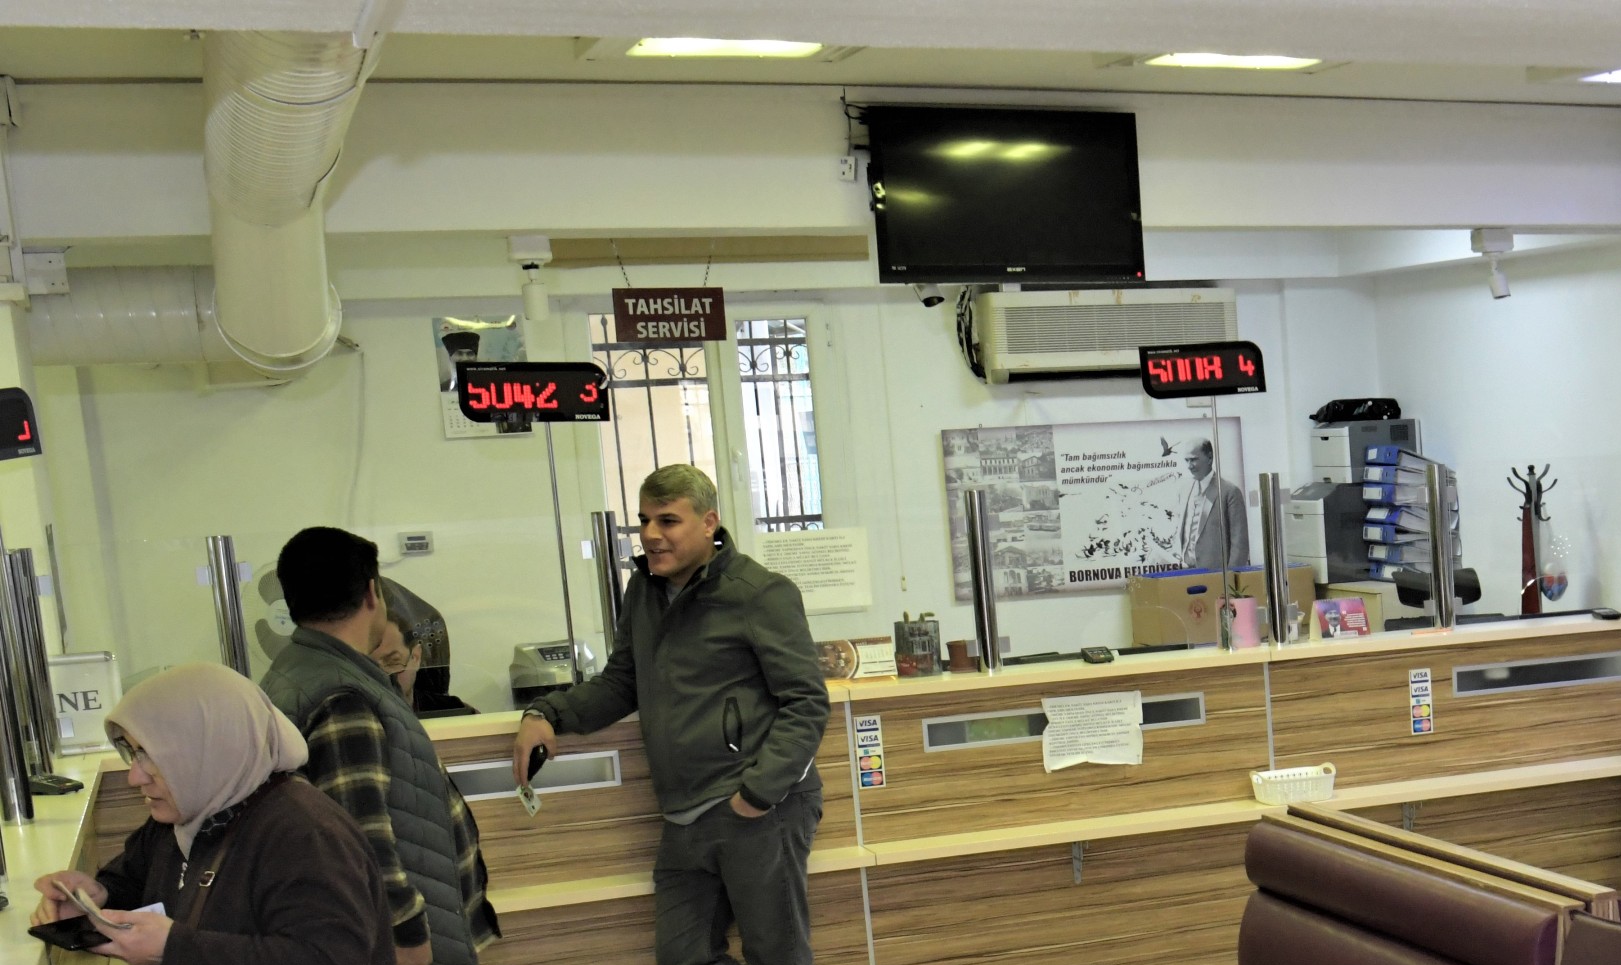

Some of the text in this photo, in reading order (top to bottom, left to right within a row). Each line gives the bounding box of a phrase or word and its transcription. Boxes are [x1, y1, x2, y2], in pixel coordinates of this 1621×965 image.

[624, 294, 713, 315] TAHSİLAT
[636, 317, 706, 338] SERVİSİ
[1238, 354, 1255, 377] 4
[1082, 451, 1126, 463] bağımsızlık
[1060, 460, 1178, 474] ancak ekonomik bağımsızlıkla
[1069, 567, 1122, 583] BORNOVA
[1413, 685, 1429, 693] VISA
[859, 719, 877, 727] VISA
[860, 735, 879, 743] VISA
